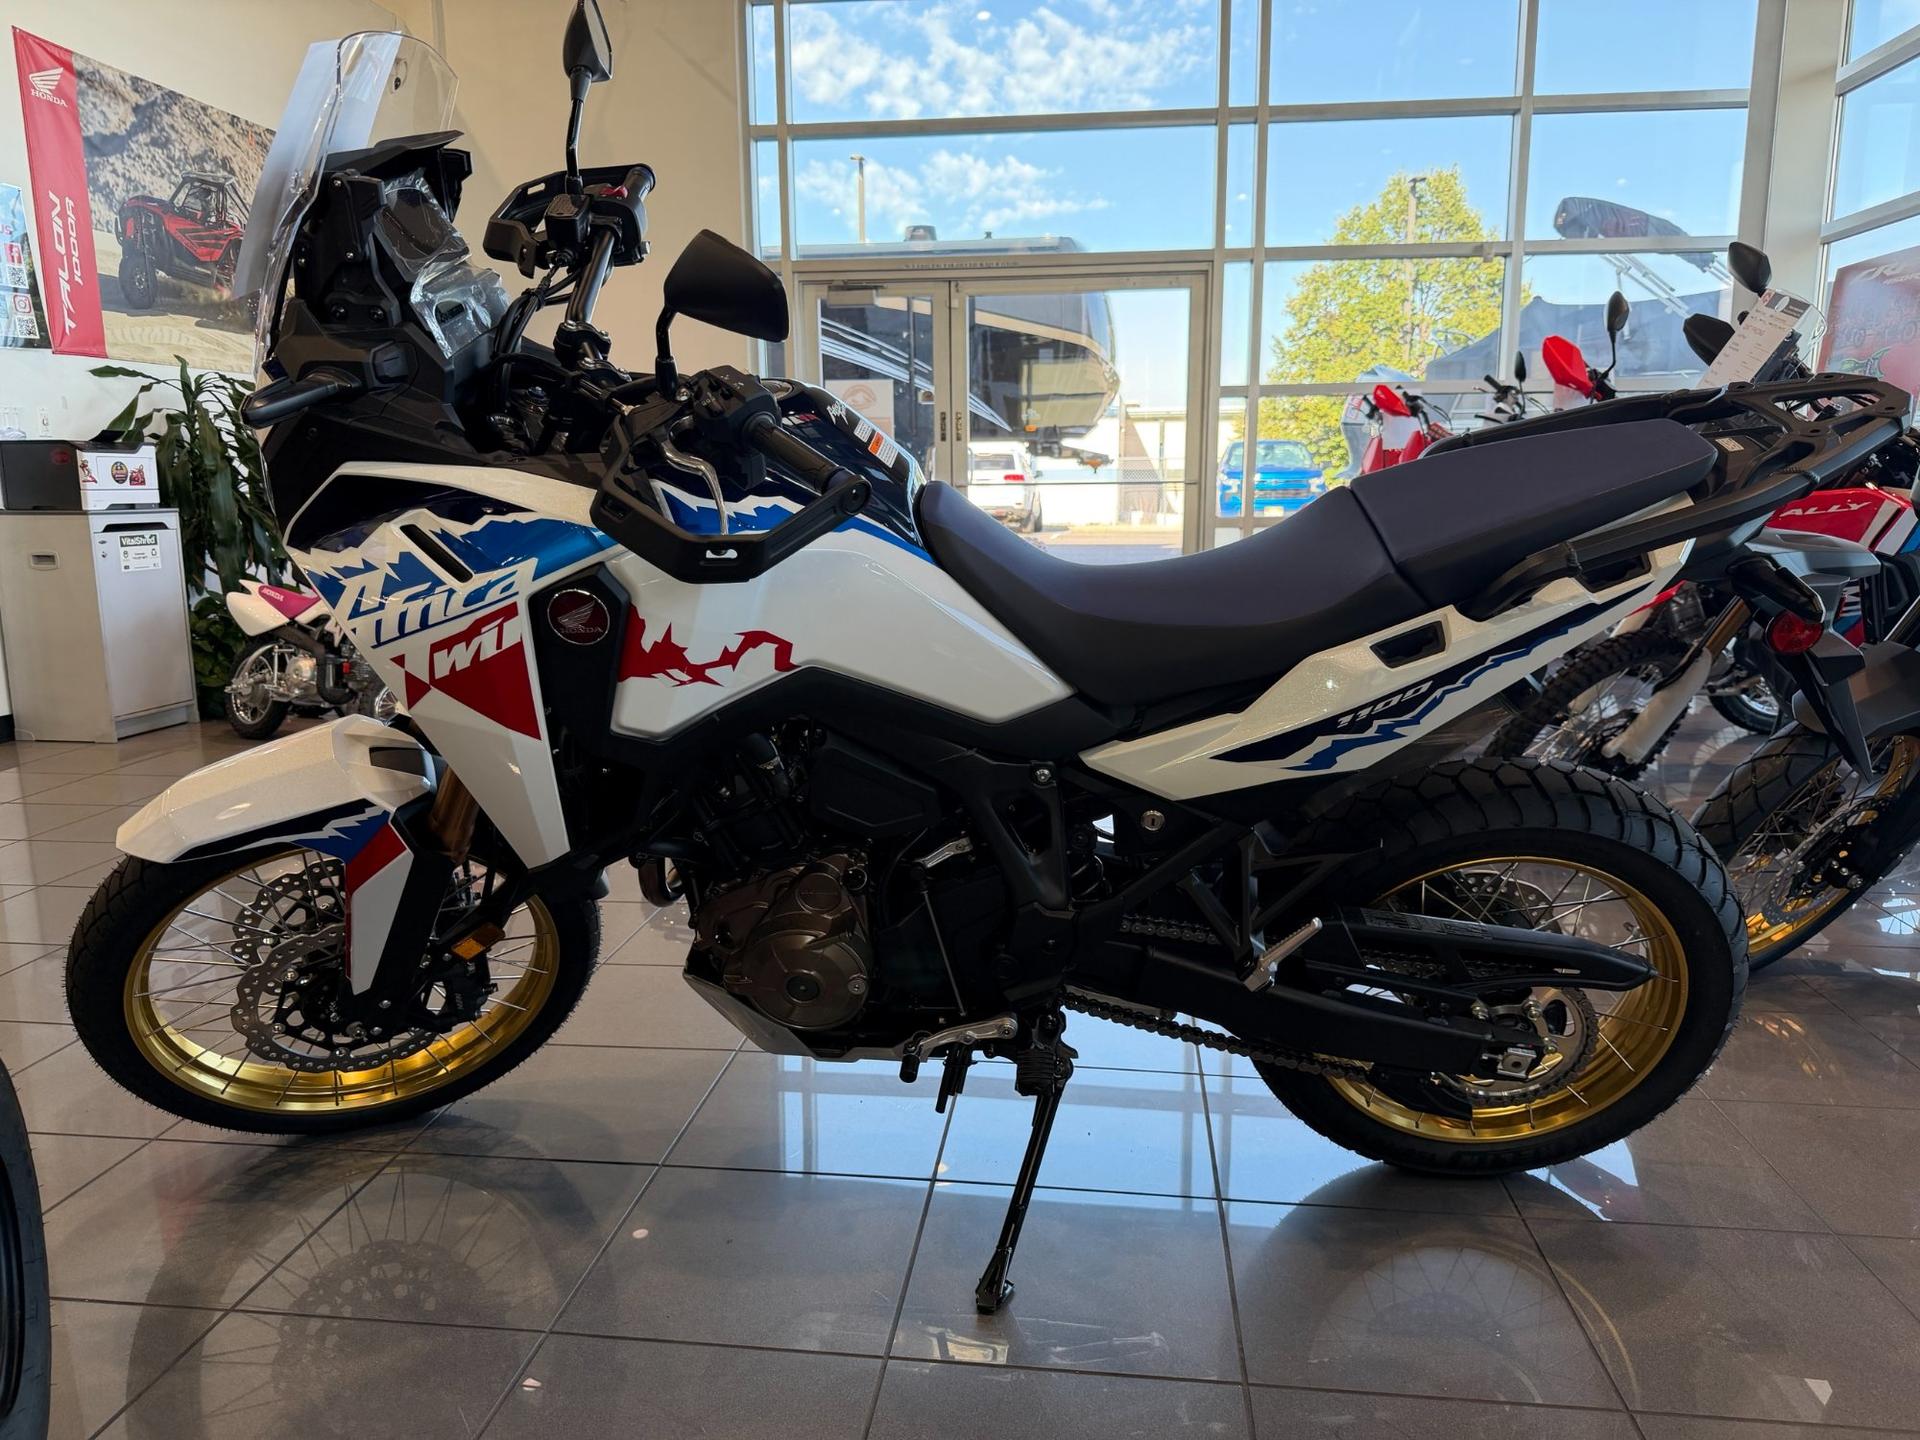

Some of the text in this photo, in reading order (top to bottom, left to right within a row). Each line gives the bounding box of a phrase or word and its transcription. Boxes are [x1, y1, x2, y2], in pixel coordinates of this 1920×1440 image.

[31, 88, 68, 108] HONDA
[48, 190, 77, 335] TALON
[1779, 501, 1872, 518] ALLY
[337, 569, 521, 648] Africa
[1337, 681, 1433, 728] 1100
